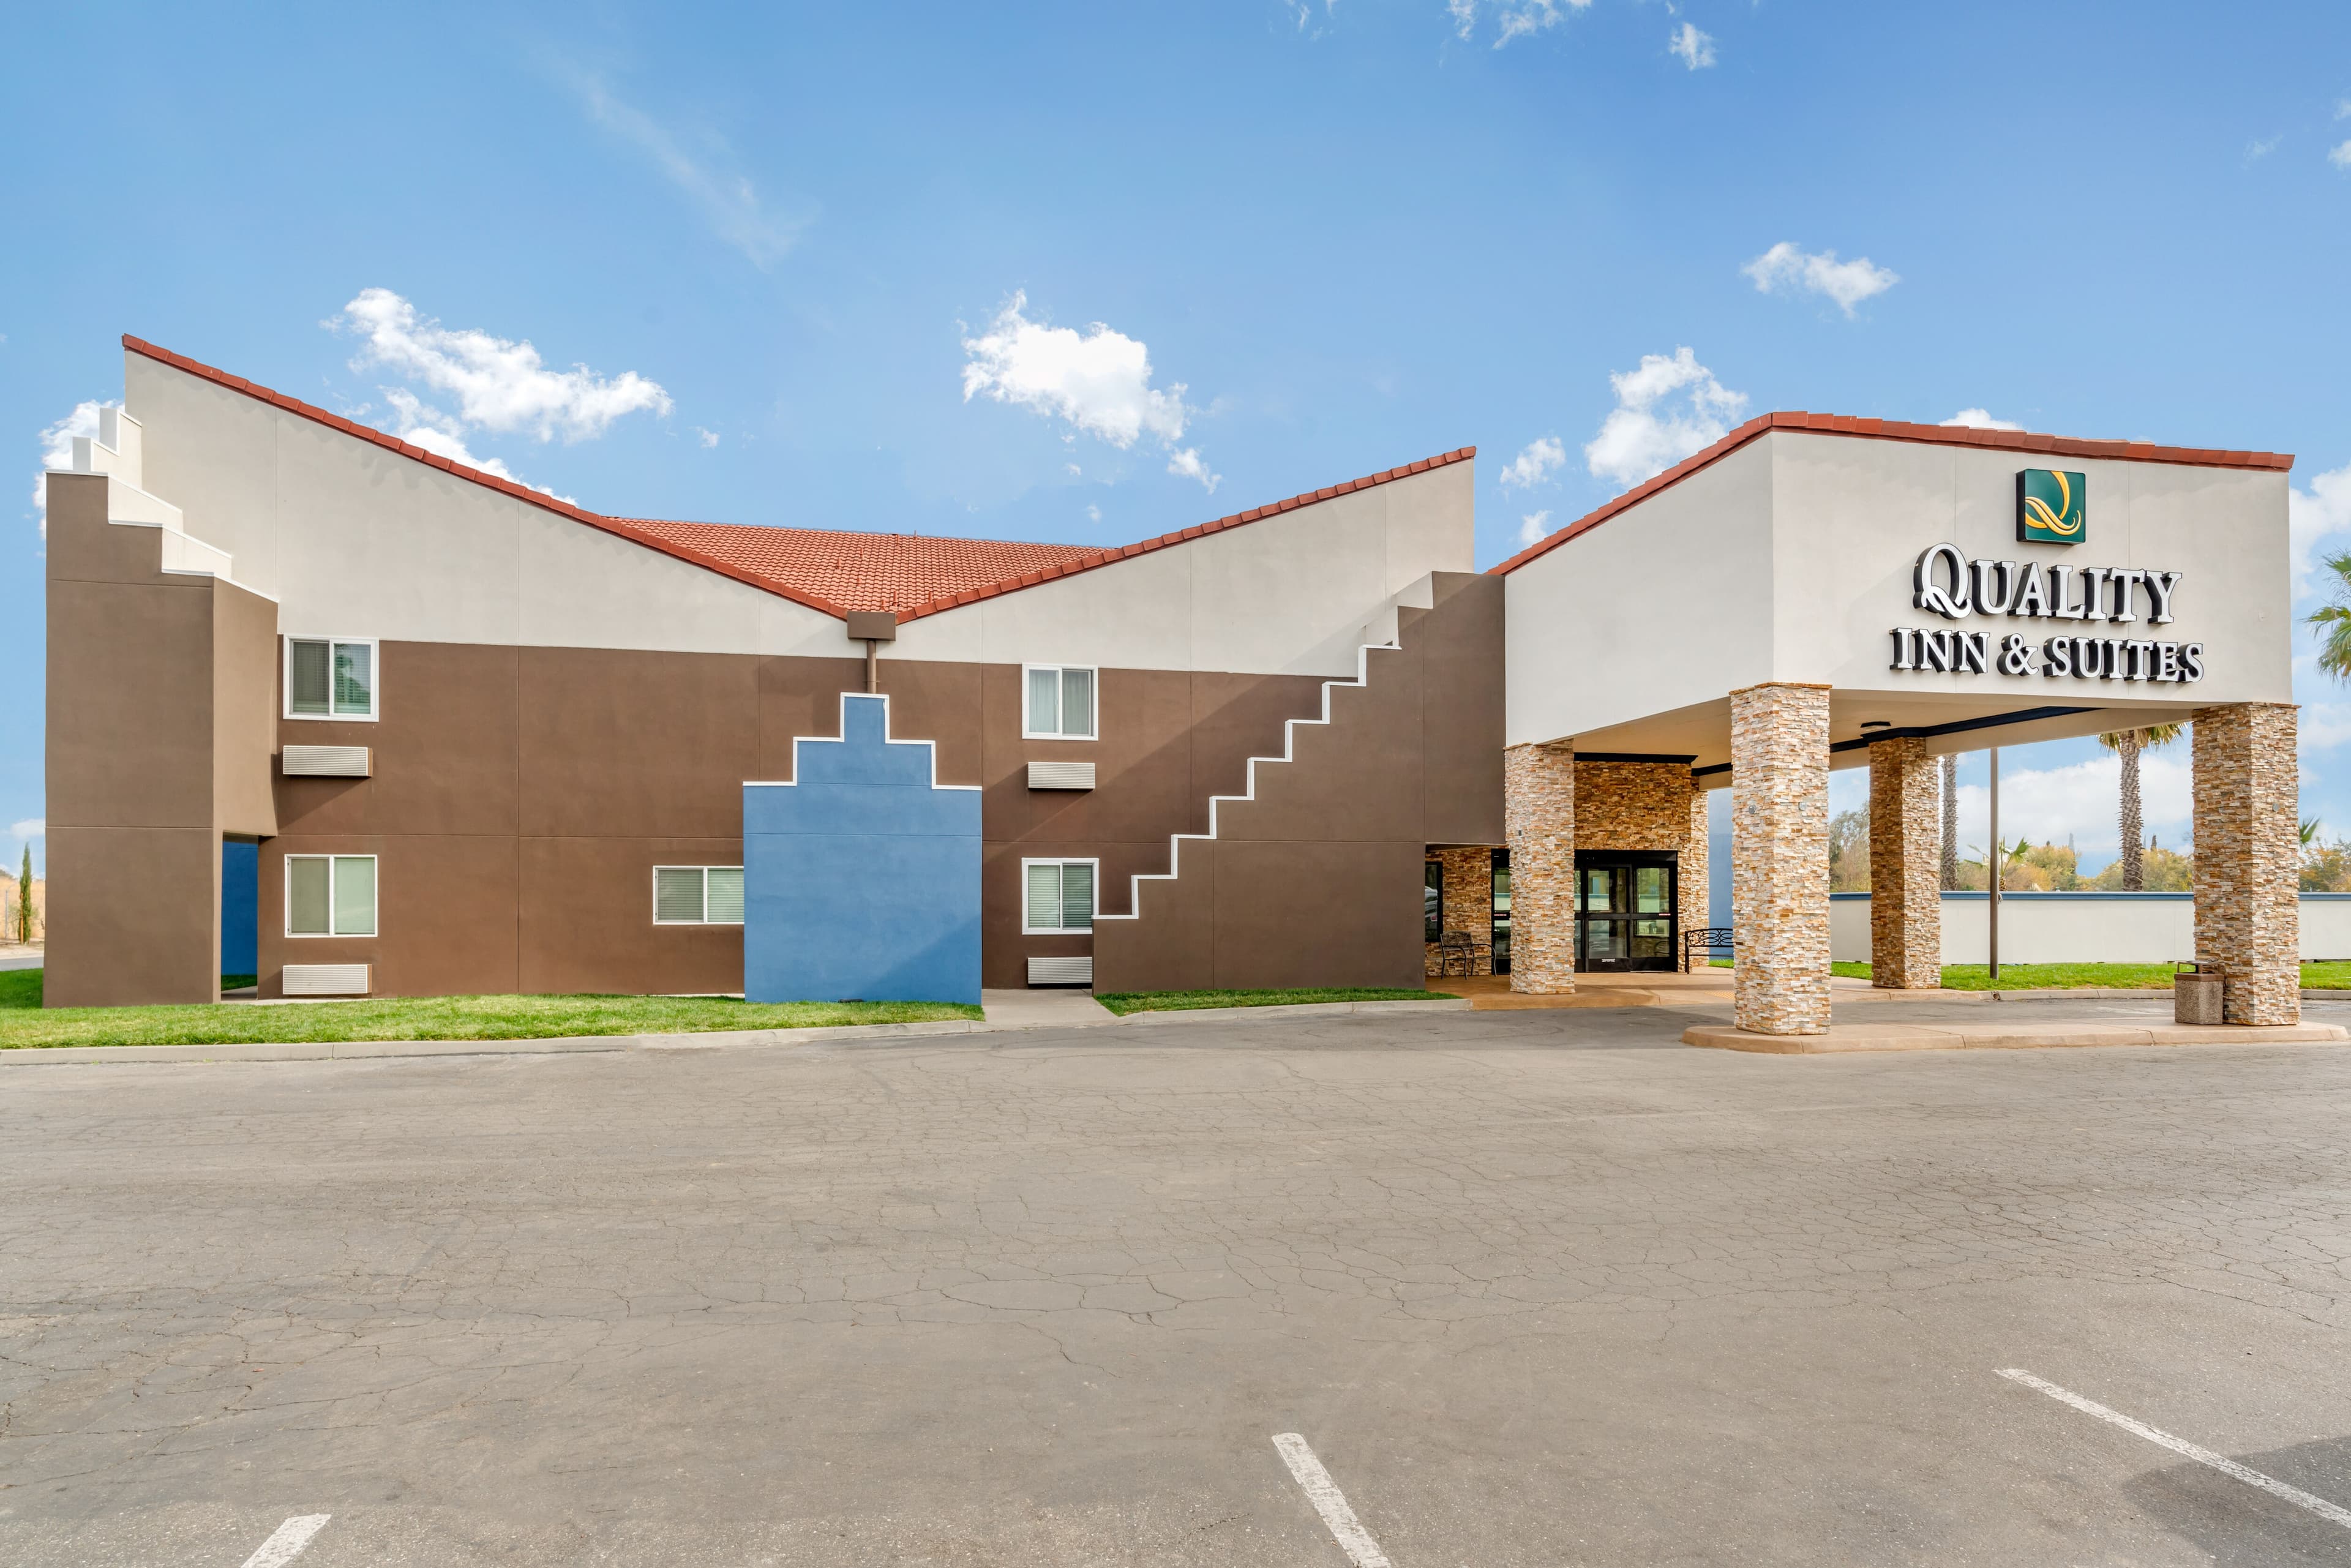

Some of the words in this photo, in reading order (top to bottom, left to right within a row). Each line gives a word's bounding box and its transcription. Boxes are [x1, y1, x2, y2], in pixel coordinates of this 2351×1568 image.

[1913, 542, 2182, 623] QUALITY
[1889, 628, 1990, 673] INN
[1997, 633, 2039, 676] &
[2043, 636, 2204, 683] SUITES
